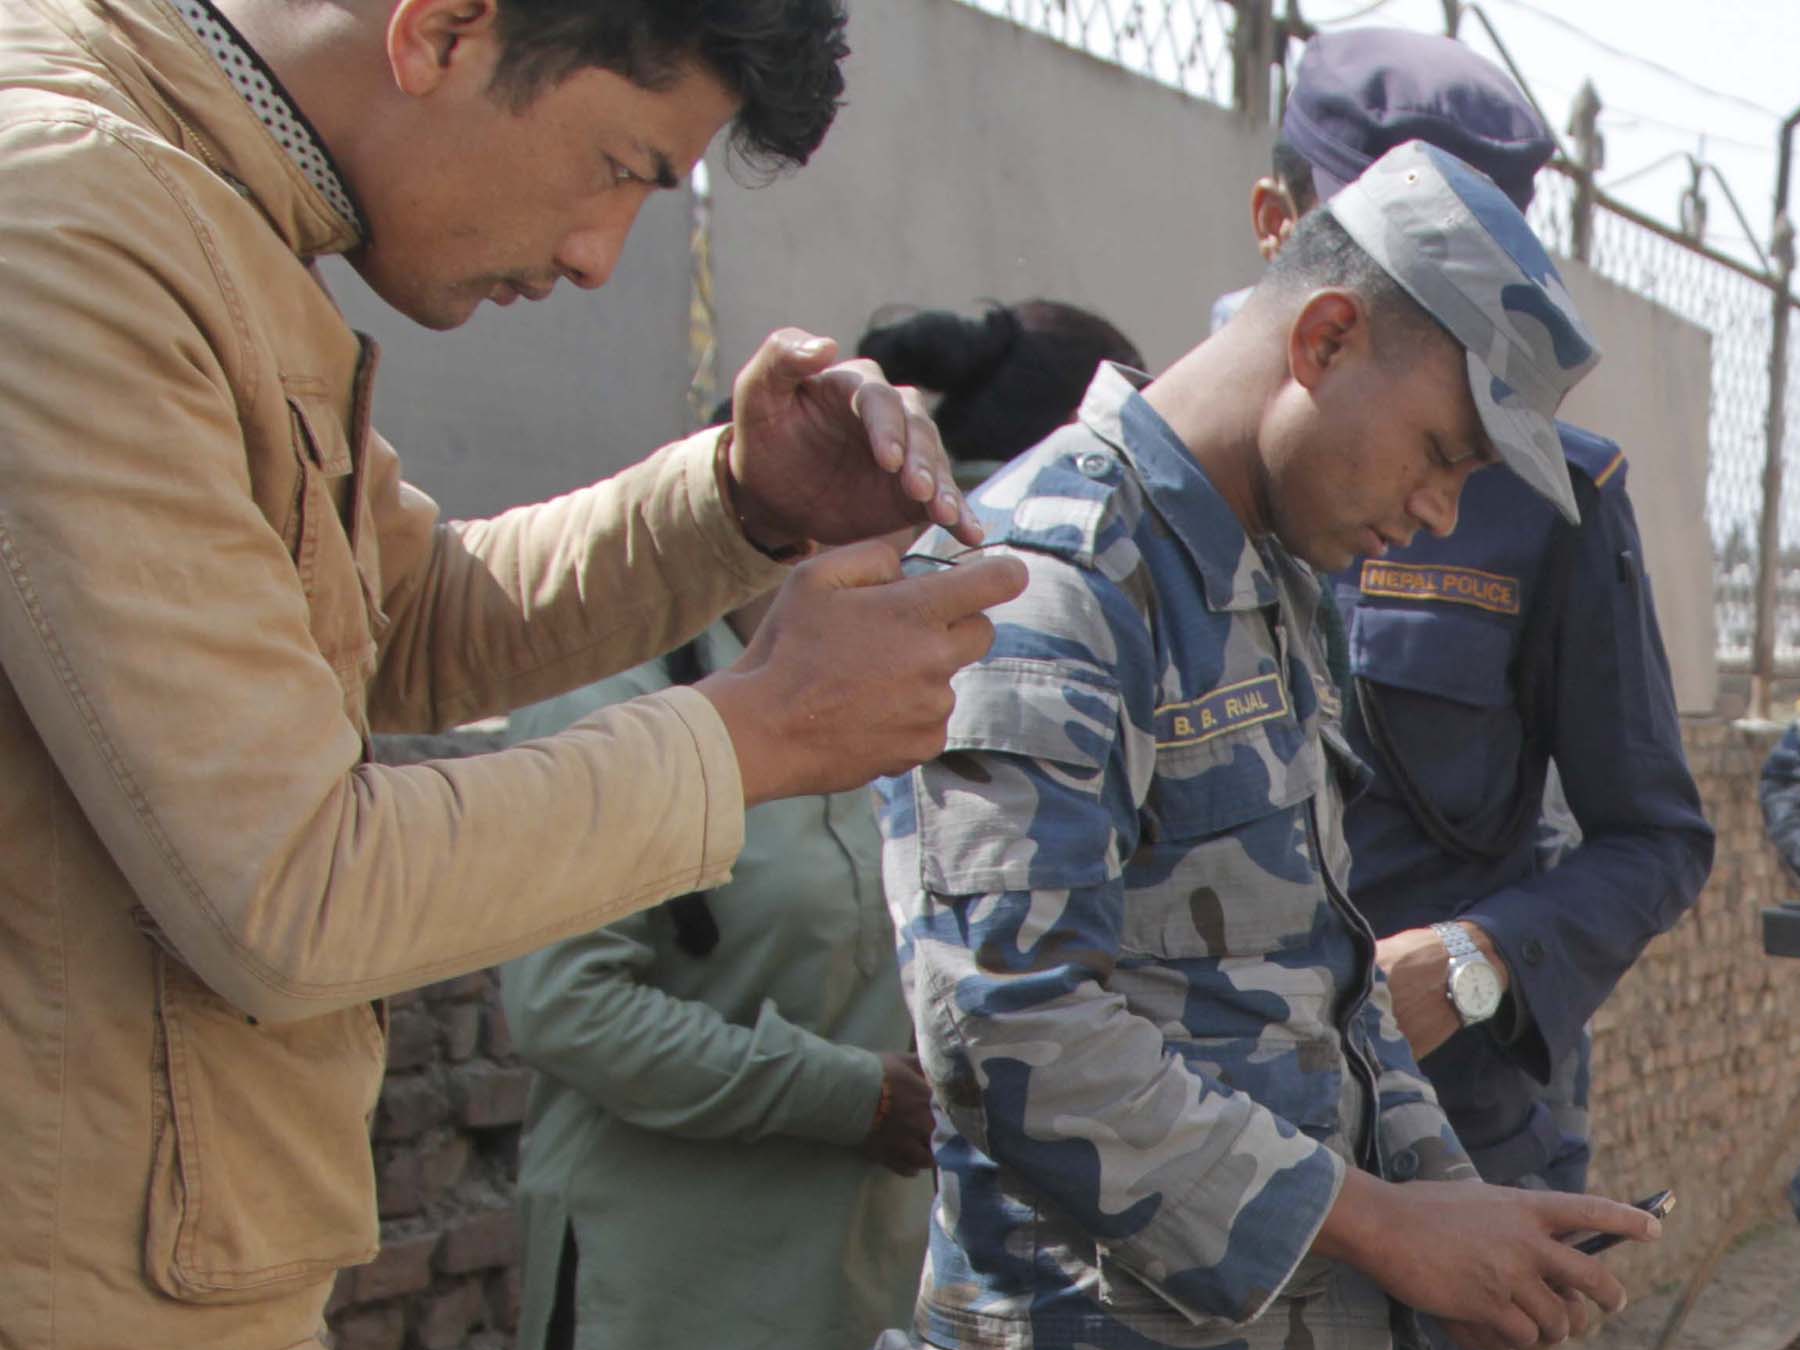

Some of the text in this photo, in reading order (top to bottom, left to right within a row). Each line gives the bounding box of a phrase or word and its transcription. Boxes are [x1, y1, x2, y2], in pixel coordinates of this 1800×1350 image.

[1369, 568, 1514, 602] NEPAL POLICE
[1173, 691, 1270, 736] B. B. RIJAL
